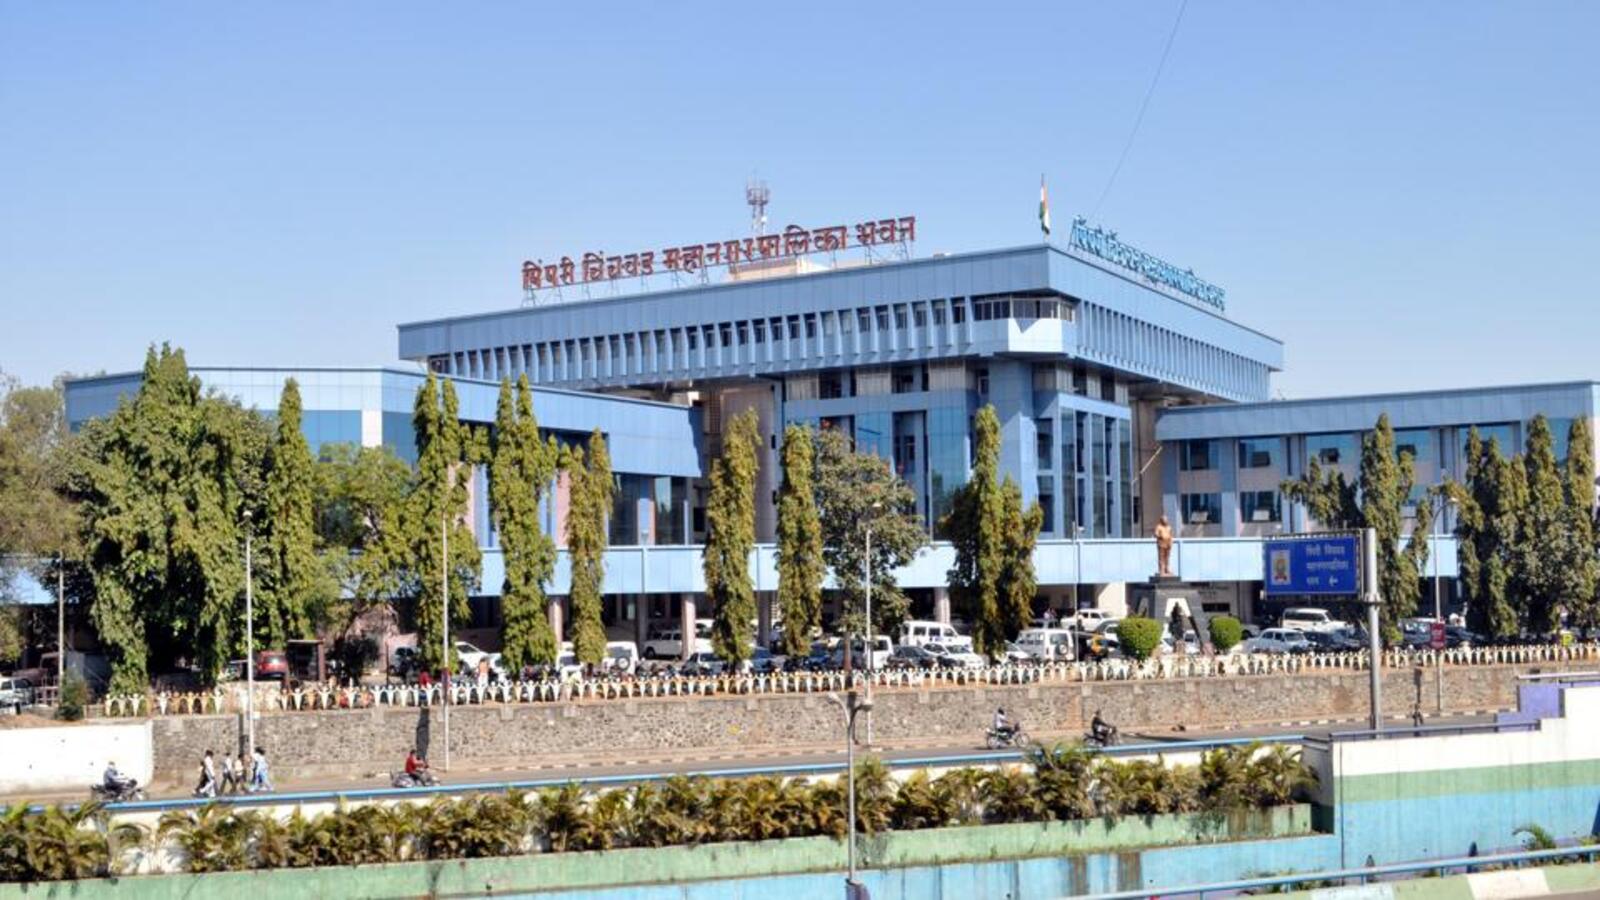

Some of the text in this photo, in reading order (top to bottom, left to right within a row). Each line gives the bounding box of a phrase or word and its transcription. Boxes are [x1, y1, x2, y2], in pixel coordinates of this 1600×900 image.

[522, 216, 916, 289] पिंपरी चिंचवड महानगरपालिका भवन
